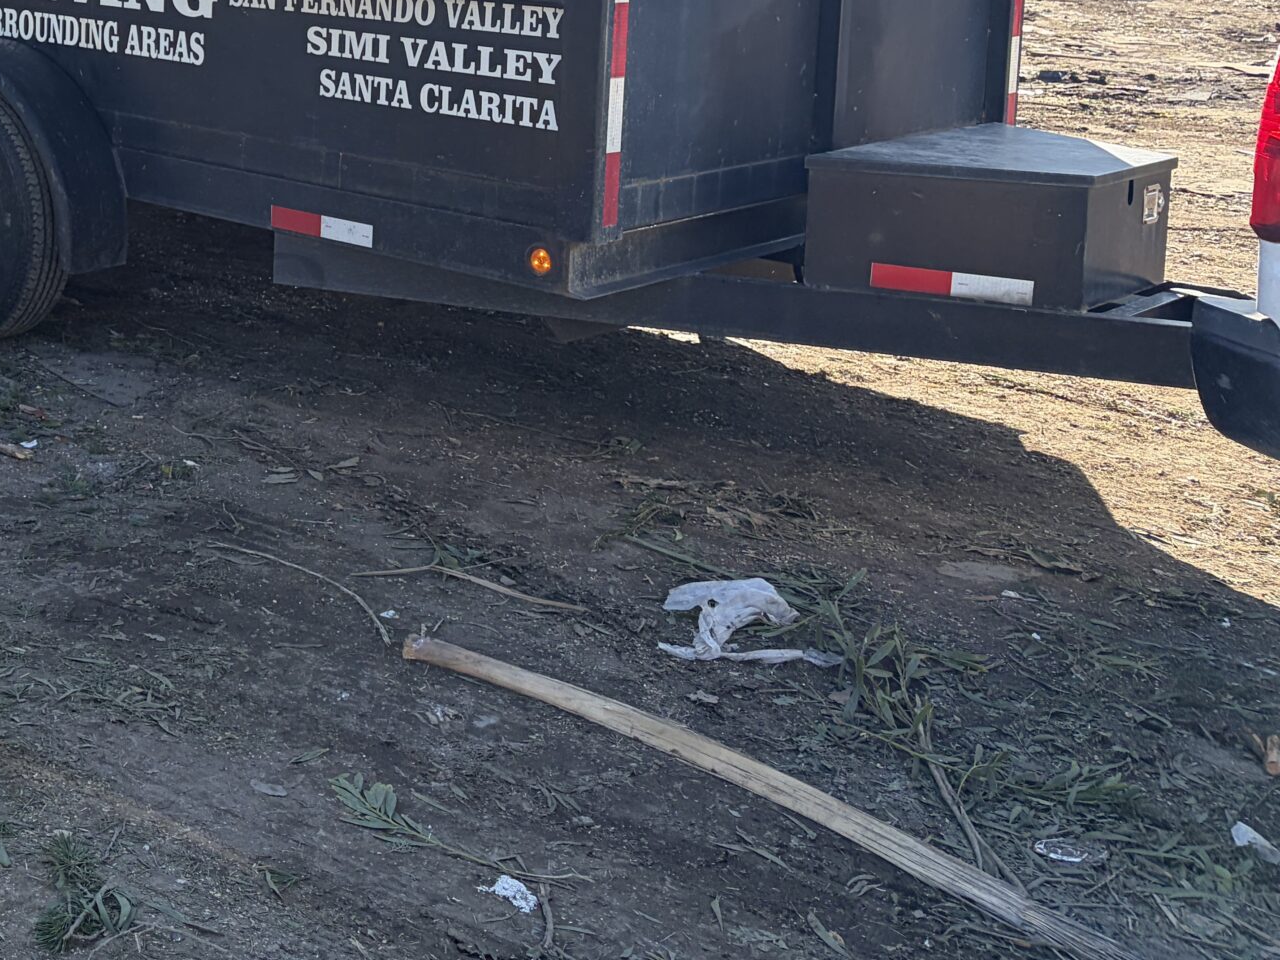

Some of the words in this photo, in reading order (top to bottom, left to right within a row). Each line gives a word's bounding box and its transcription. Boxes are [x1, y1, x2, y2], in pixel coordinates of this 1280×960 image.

[124, 24, 205, 66] AREAS
[306, 25, 391, 64] SIMI
[399, 36, 562, 85] VALLEY
[319, 68, 413, 110] SANTA
[419, 82, 560, 132] CLARITA
